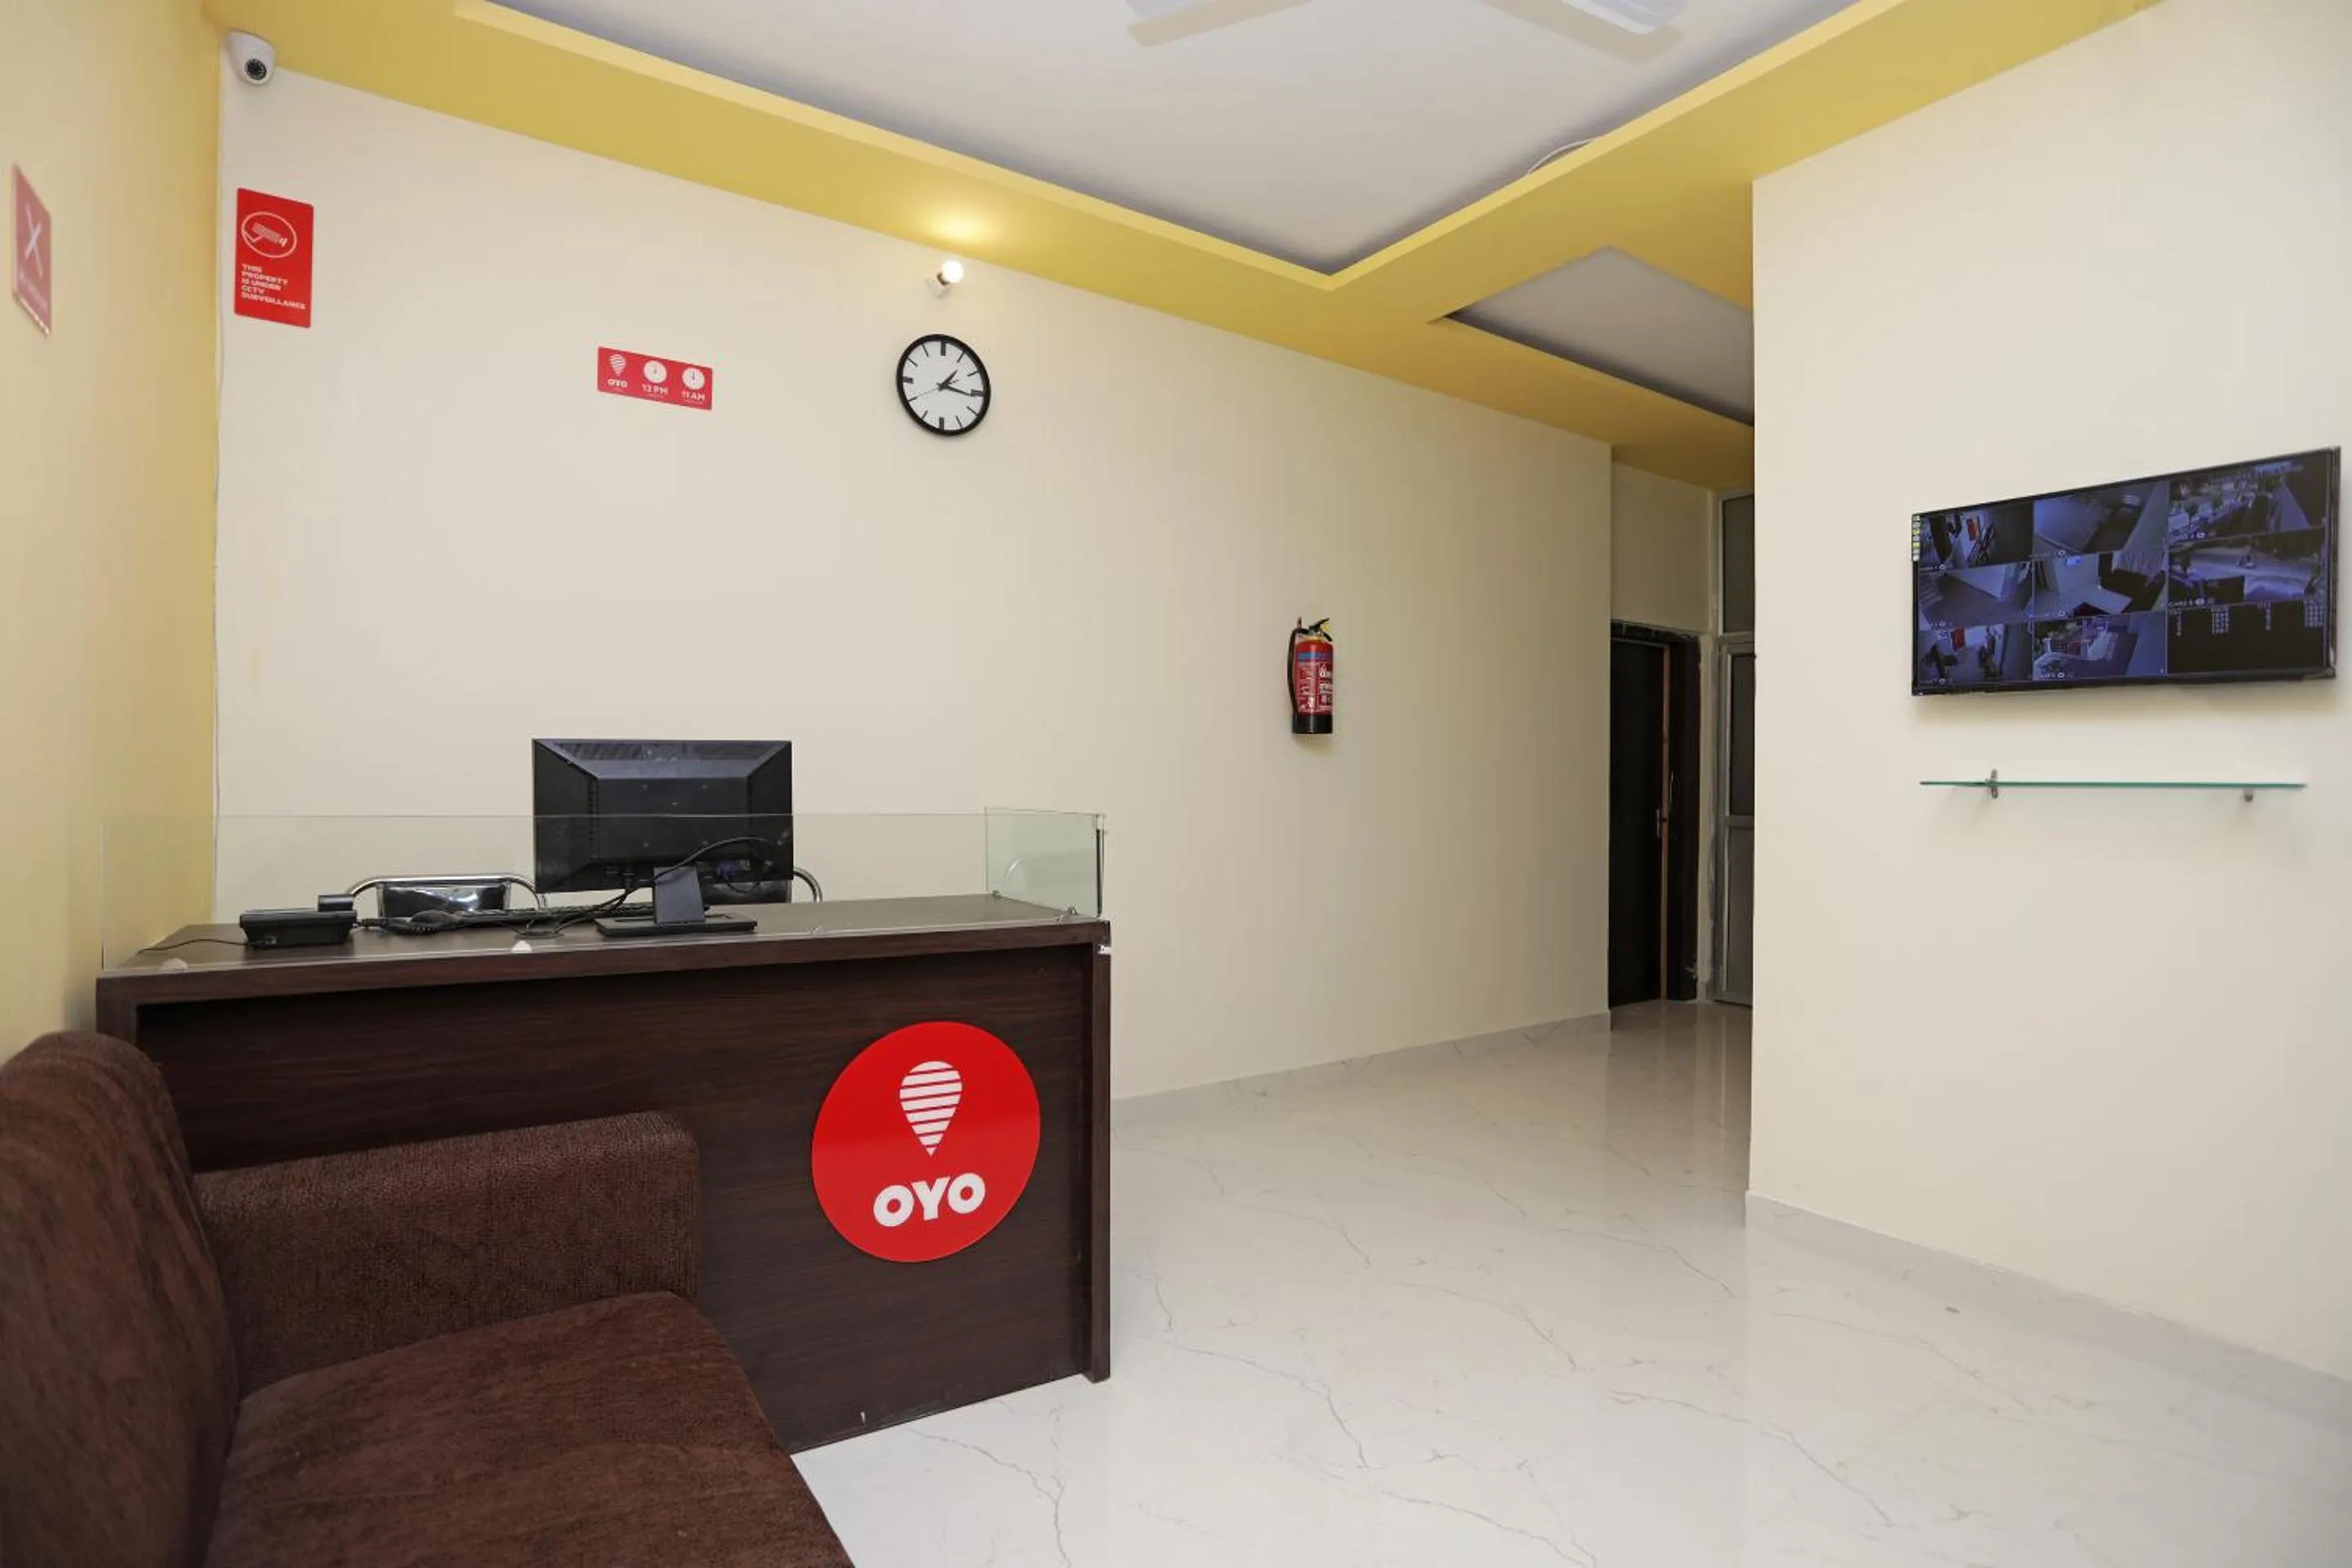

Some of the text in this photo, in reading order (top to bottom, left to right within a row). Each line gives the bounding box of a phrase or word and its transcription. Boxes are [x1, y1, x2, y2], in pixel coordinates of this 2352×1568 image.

[242, 264, 262, 273] THIS
[241, 270, 288, 285] PROPERTY
[241, 285, 265, 295] CCTV
[251, 279, 282, 291] UNDER
[241, 292, 306, 310] SURVEILLANCE
[607, 378, 628, 388] OYO
[641, 384, 653, 393] 12
[653, 385, 668, 395] PM
[681, 390, 690, 399] 11
[690, 392, 706, 401] AM
[873, 1172, 987, 1227] OYO
